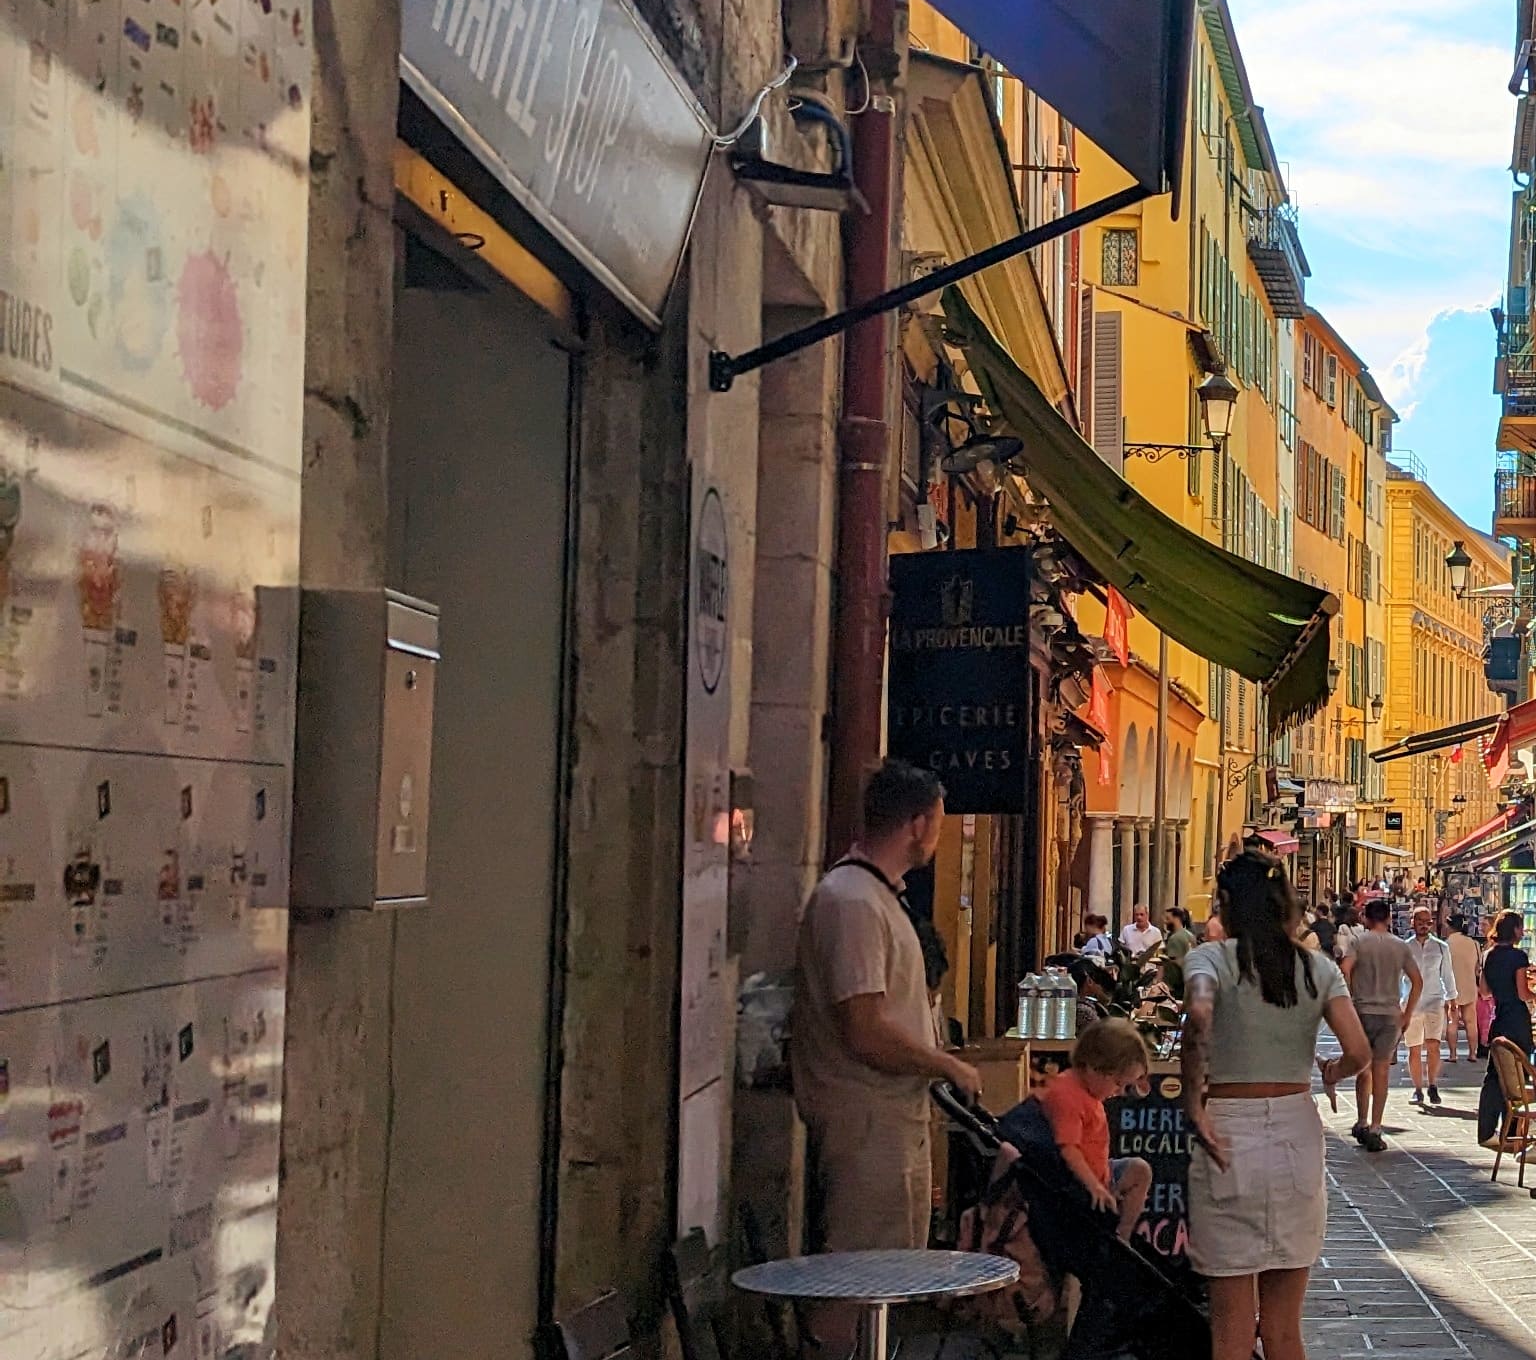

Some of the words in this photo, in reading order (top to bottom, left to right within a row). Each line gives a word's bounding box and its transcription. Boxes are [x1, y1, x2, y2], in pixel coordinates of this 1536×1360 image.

[915, 624, 1026, 652] PROVENÇALE
[929, 749, 1011, 771] CAVES
[1120, 1108, 1185, 1132] BIERE
